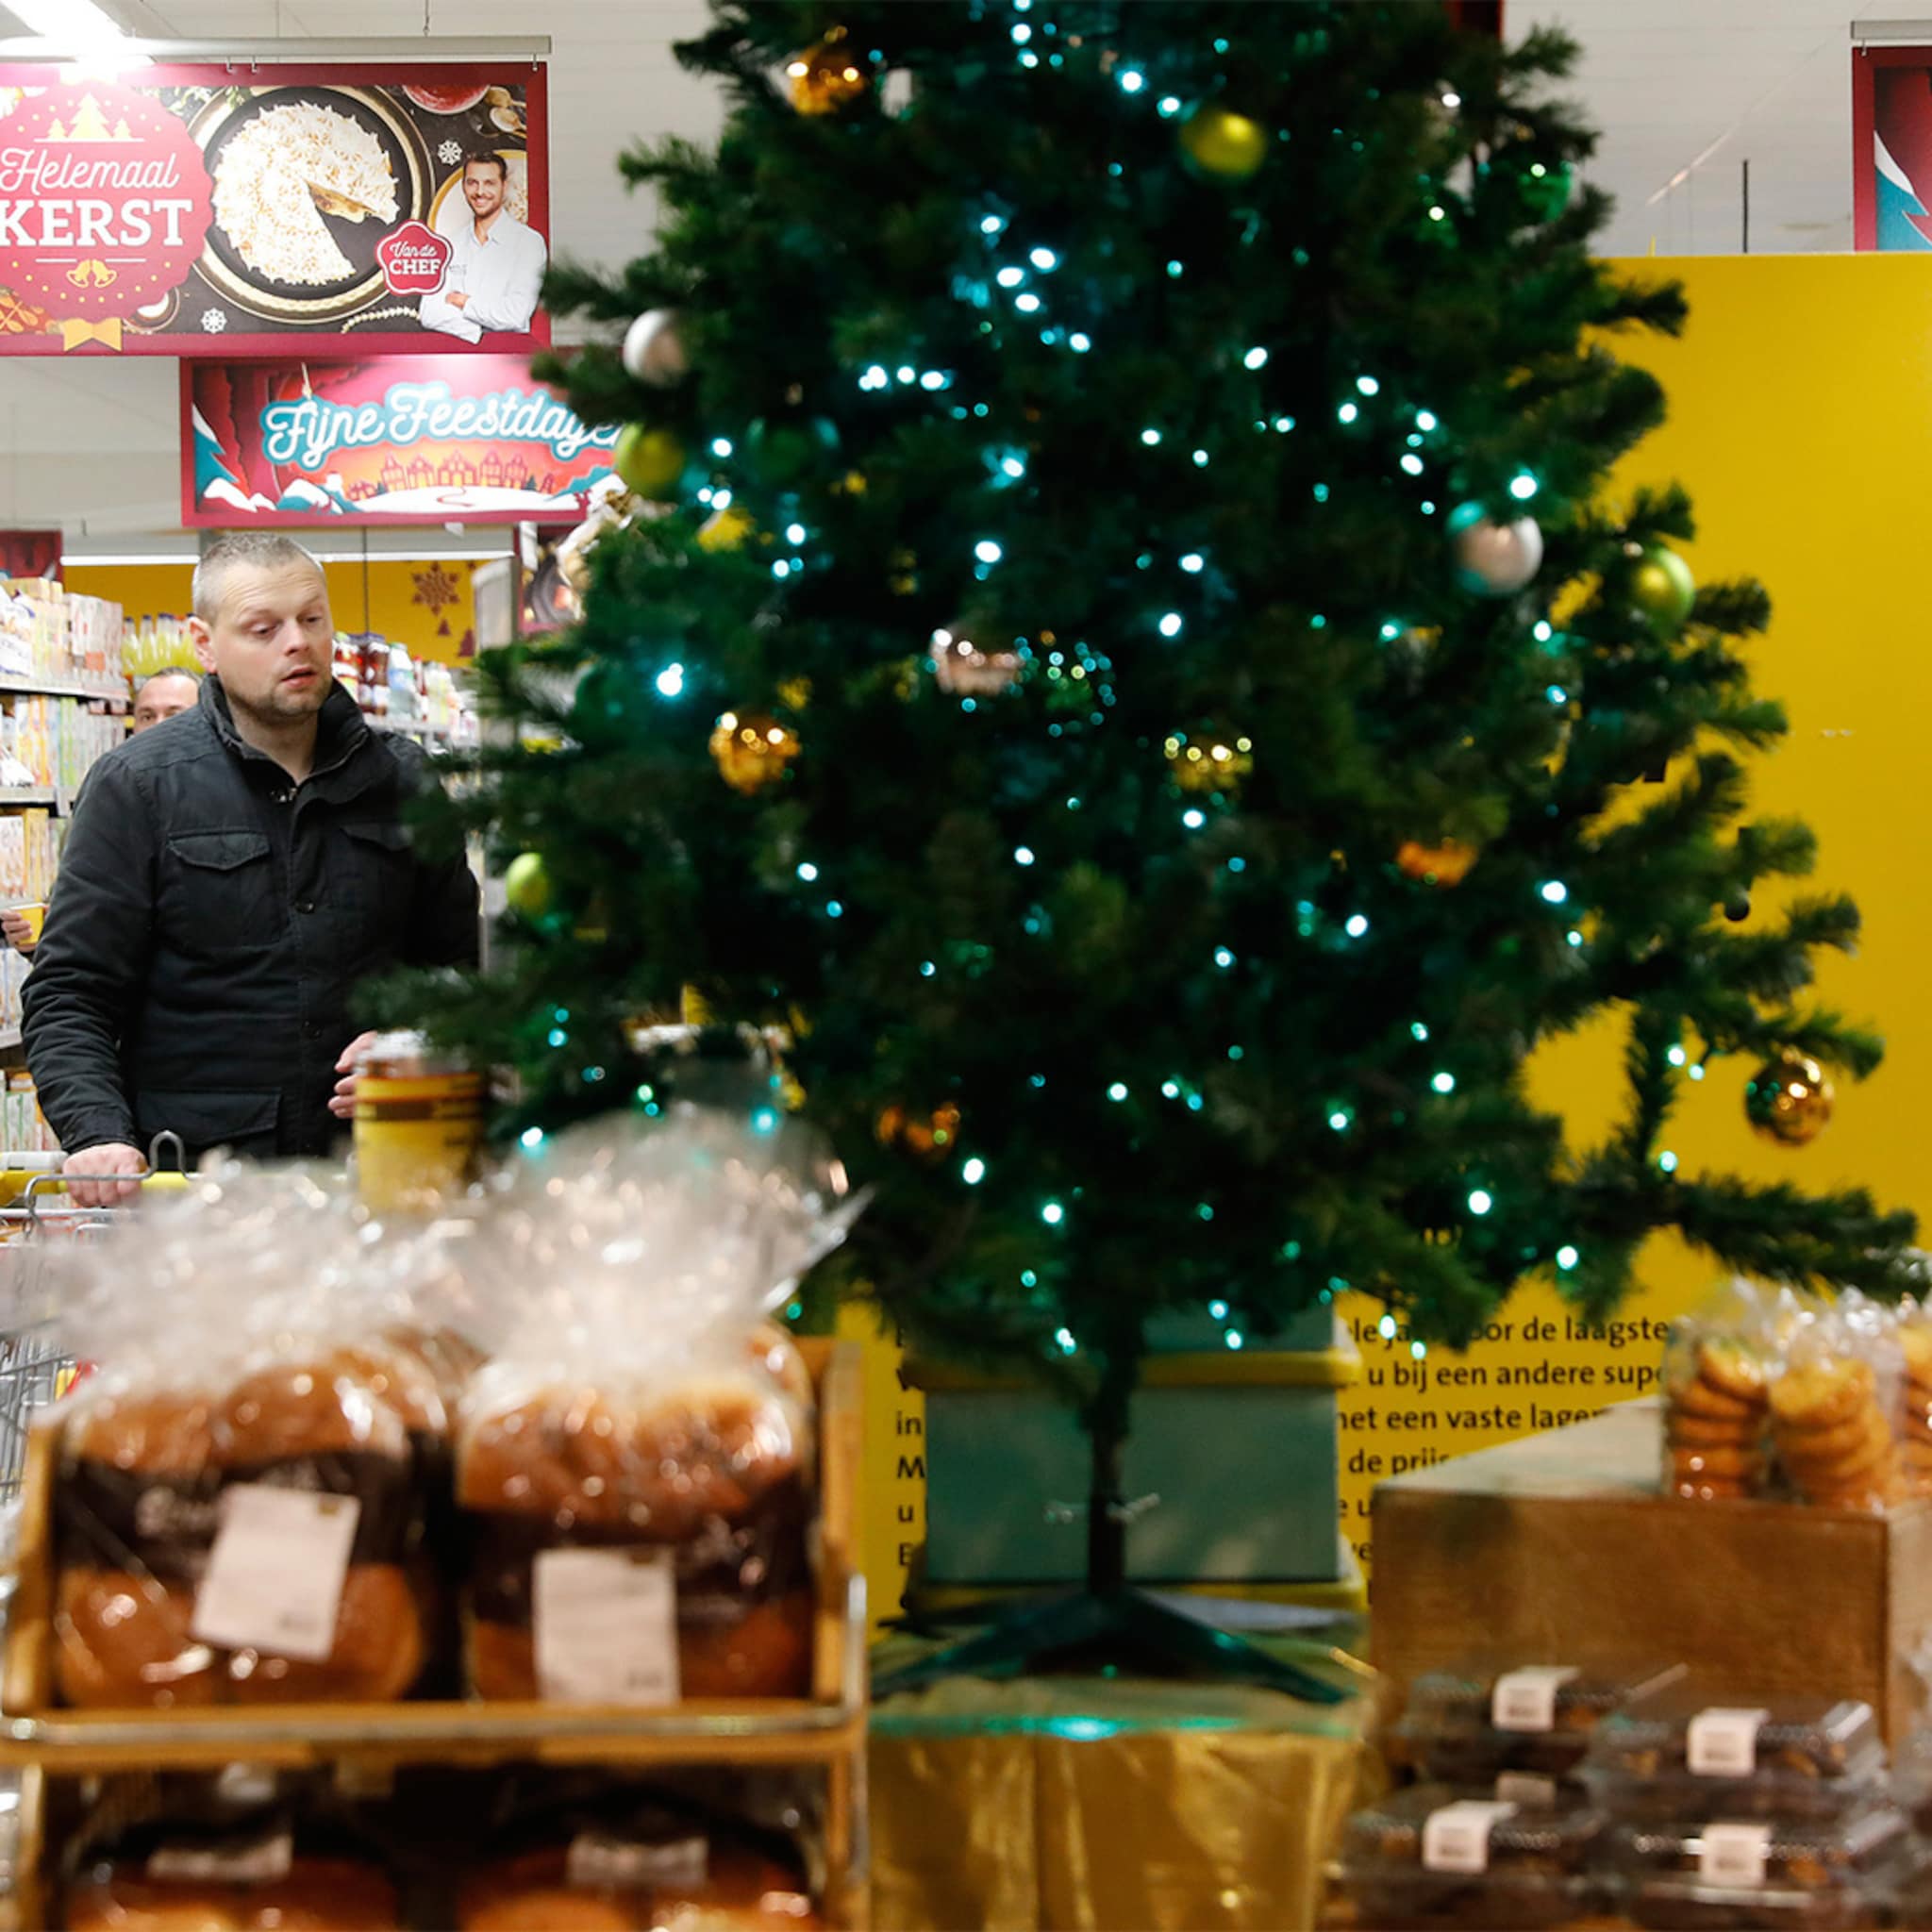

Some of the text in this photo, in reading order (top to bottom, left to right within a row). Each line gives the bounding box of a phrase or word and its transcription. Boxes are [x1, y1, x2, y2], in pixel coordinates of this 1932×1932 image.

[0, 147, 180, 196] Helemaal
[0, 198, 193, 247] KERST
[389, 241, 438, 258] Van de
[389, 258, 441, 275] CHEF
[265, 401, 386, 468] Fijne
[1523, 1316, 1557, 1341] de
[1566, 1316, 1668, 1349] laagste
[1368, 1367, 1384, 1386] u
[1393, 1359, 1427, 1394] bij
[1436, 1367, 1488, 1386] een
[1496, 1358, 1595, 1386] andere
[1387, 1410, 1438, 1429] een
[1446, 1405, 1523, 1430] vaste
[1348, 1448, 1383, 1474] de
